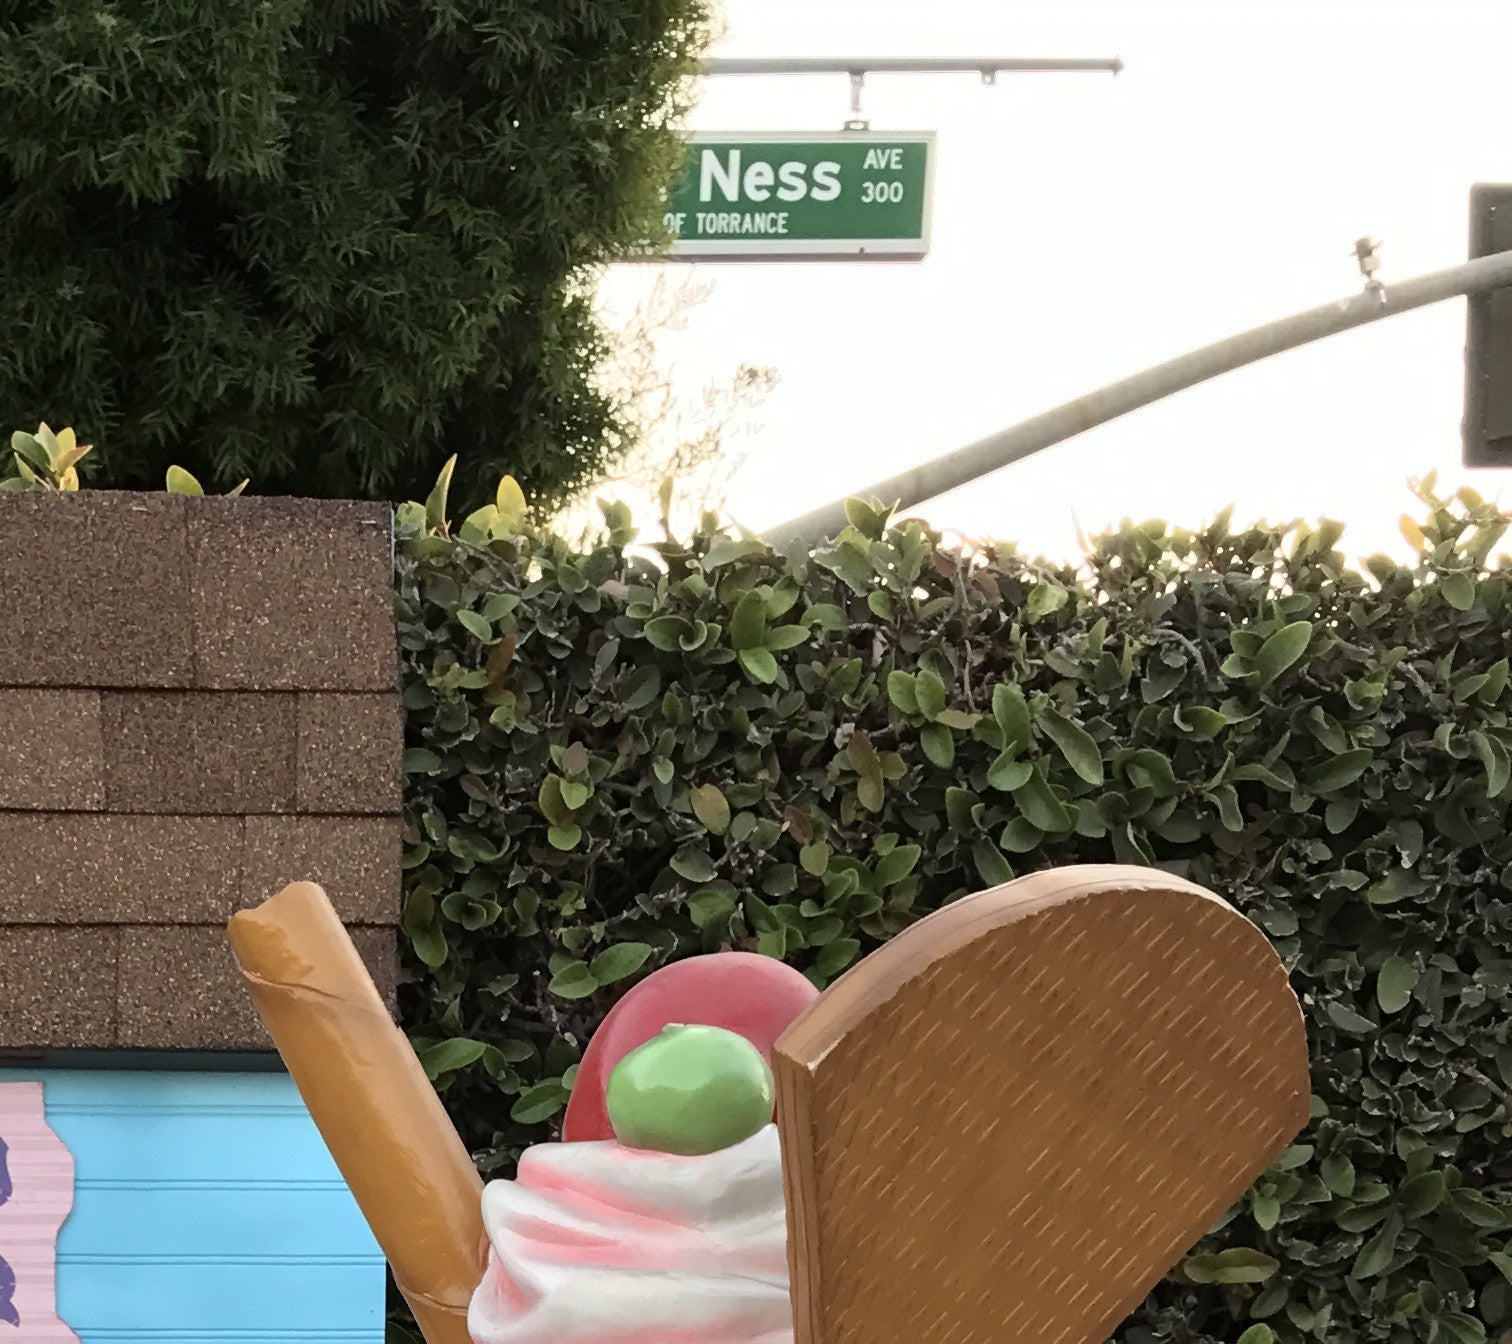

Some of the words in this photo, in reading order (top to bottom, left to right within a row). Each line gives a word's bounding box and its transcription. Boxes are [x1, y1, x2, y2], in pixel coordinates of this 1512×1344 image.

[863, 148, 904, 170] AVE
[699, 149, 842, 202] Ness
[861, 181, 904, 203] 300
[662, 212, 687, 234] OF
[696, 212, 789, 234] TORRANCE
